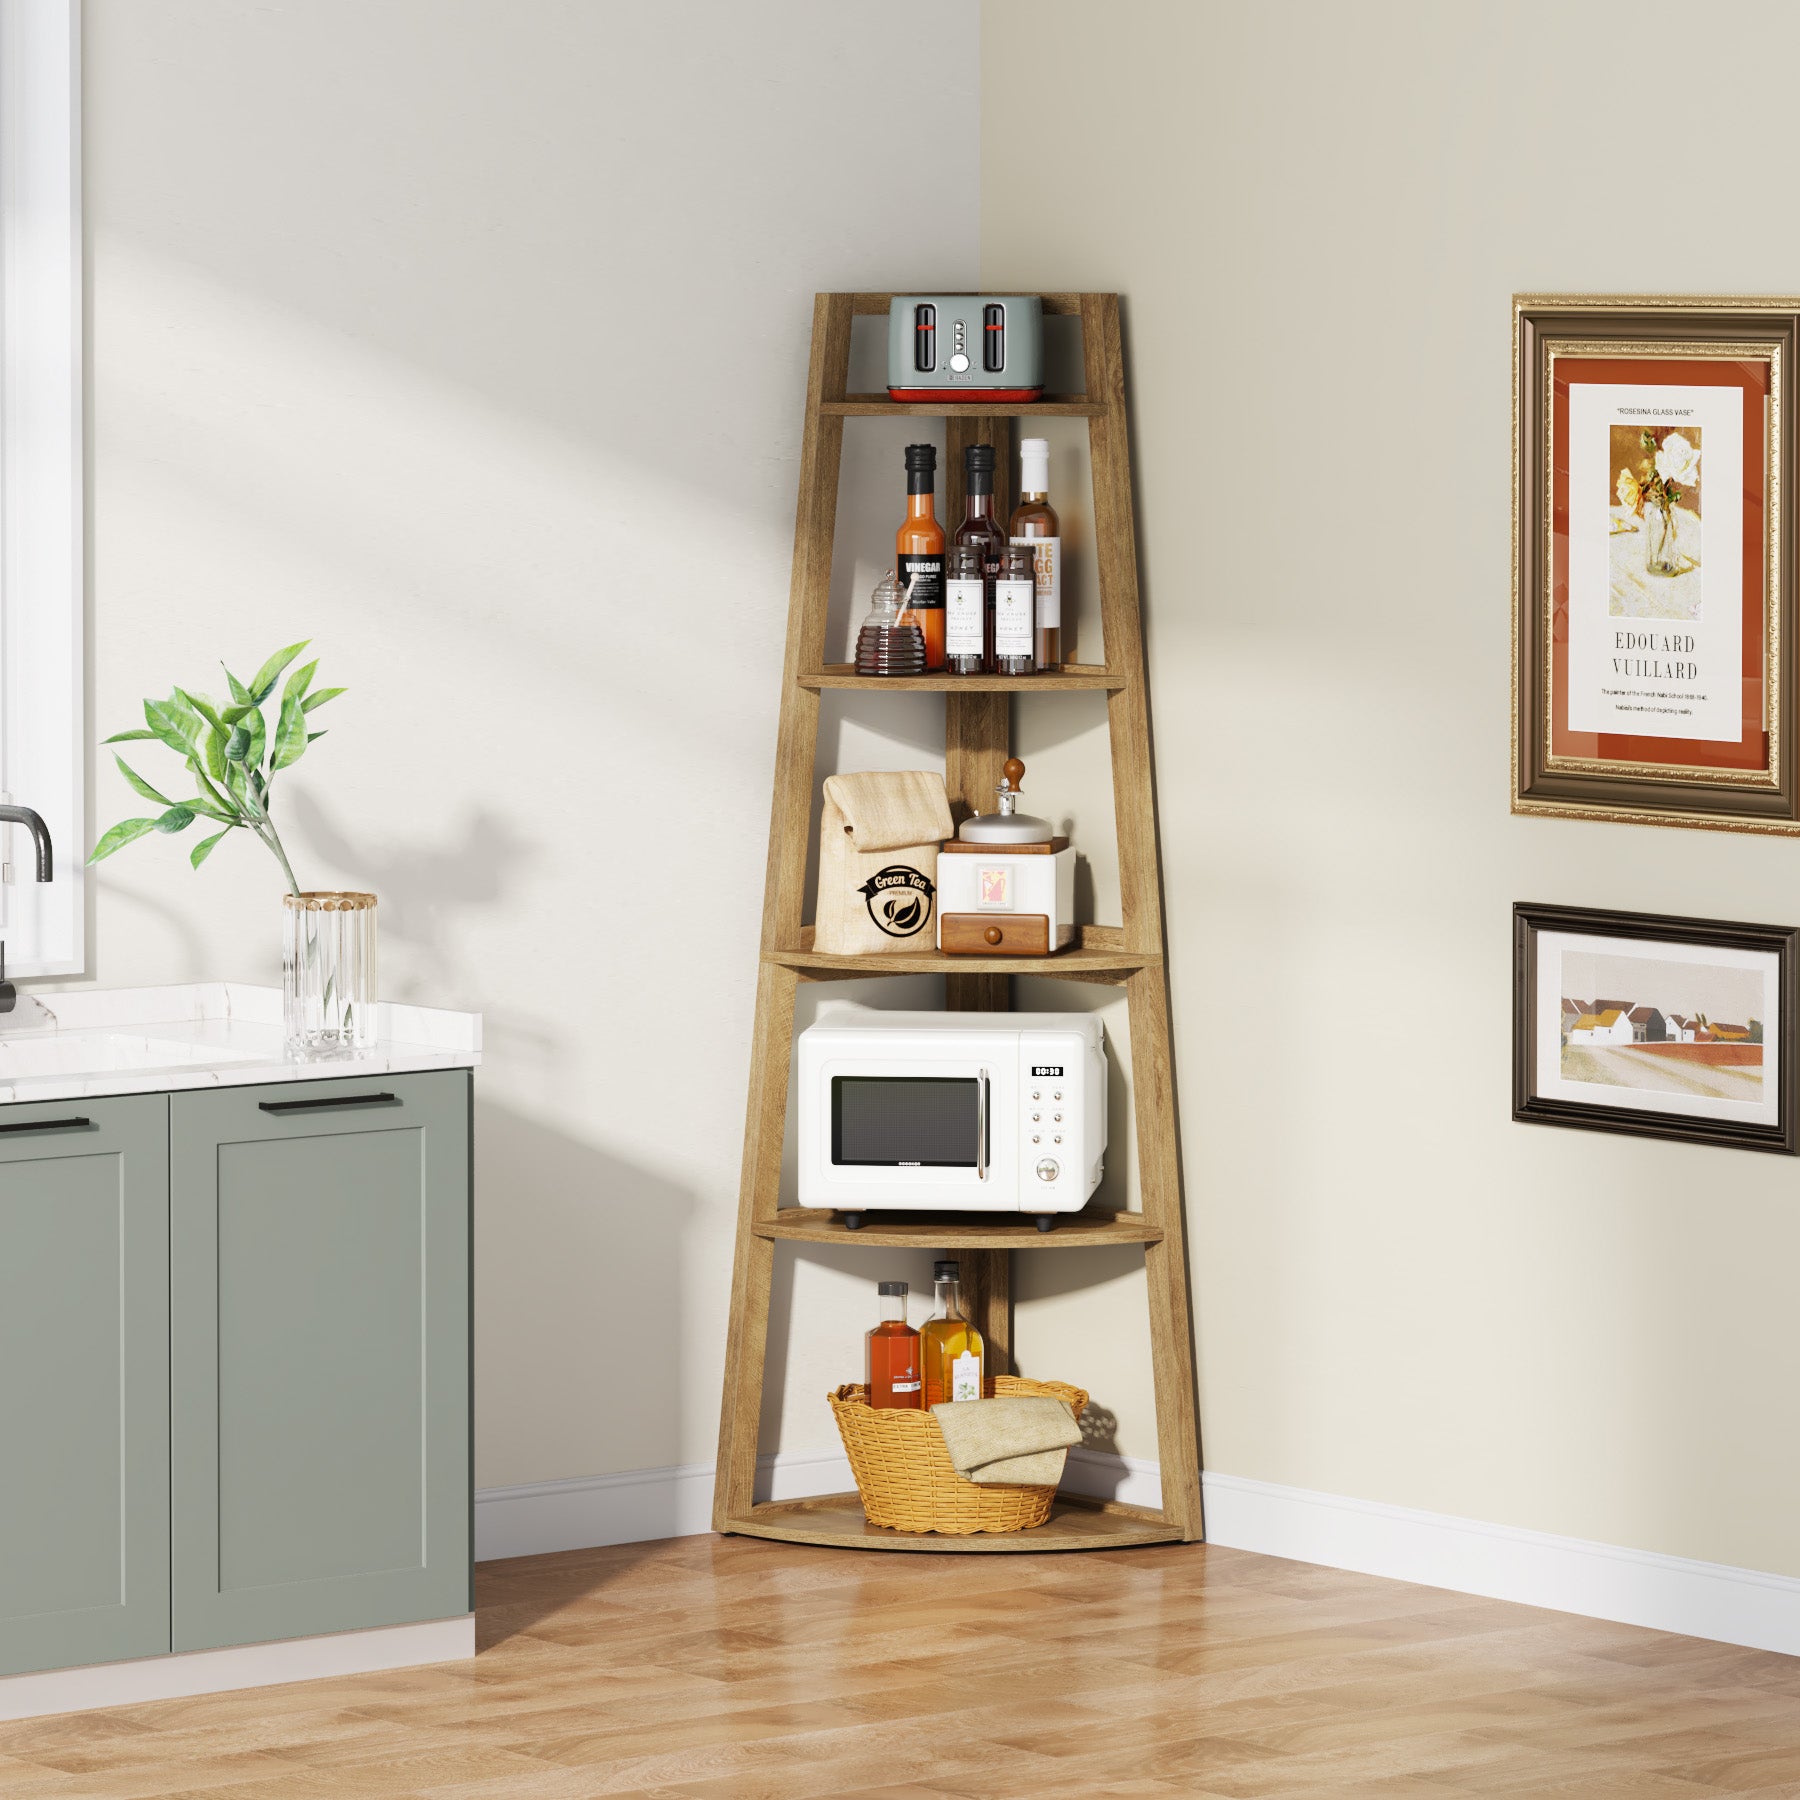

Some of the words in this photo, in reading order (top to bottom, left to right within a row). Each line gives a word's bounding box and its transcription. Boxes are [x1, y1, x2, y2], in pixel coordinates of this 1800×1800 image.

[1652, 408, 1673, 416] GLASS
[905, 562, 941, 573] VINEGAR
[1615, 631, 1695, 653] EDOUARD
[1612, 658, 1697, 680] VUILLARD
[874, 875, 905, 889] Green
[908, 873, 927, 890] Tea
